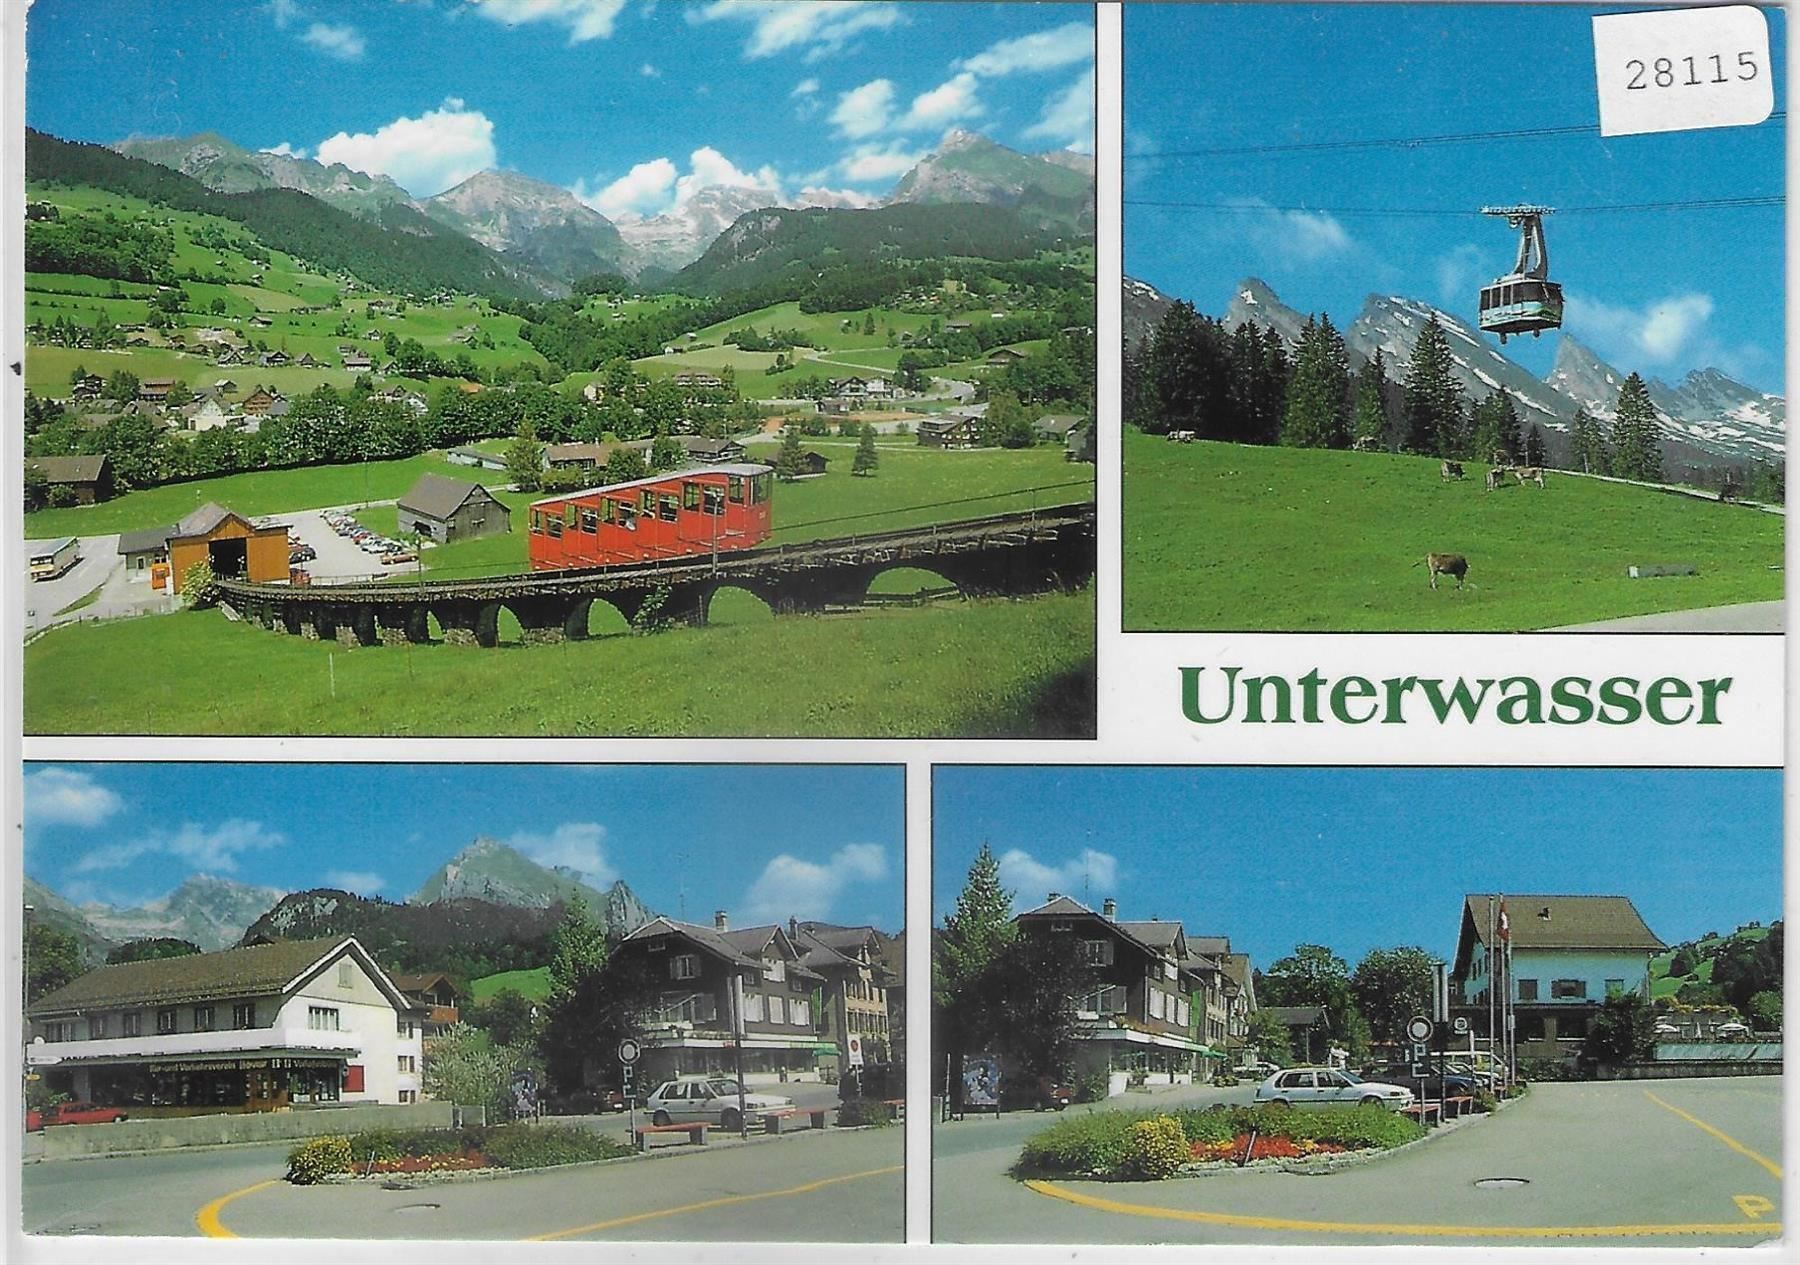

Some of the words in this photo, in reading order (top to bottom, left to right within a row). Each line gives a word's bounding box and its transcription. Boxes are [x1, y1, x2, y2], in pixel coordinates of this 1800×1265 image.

[1625, 51, 1758, 90] 28115
[1178, 666, 1733, 725] Unterwasser
[1414, 1043, 1426, 1061] P
[623, 1066, 633, 1082] P
[1731, 1194, 1776, 1219] P
